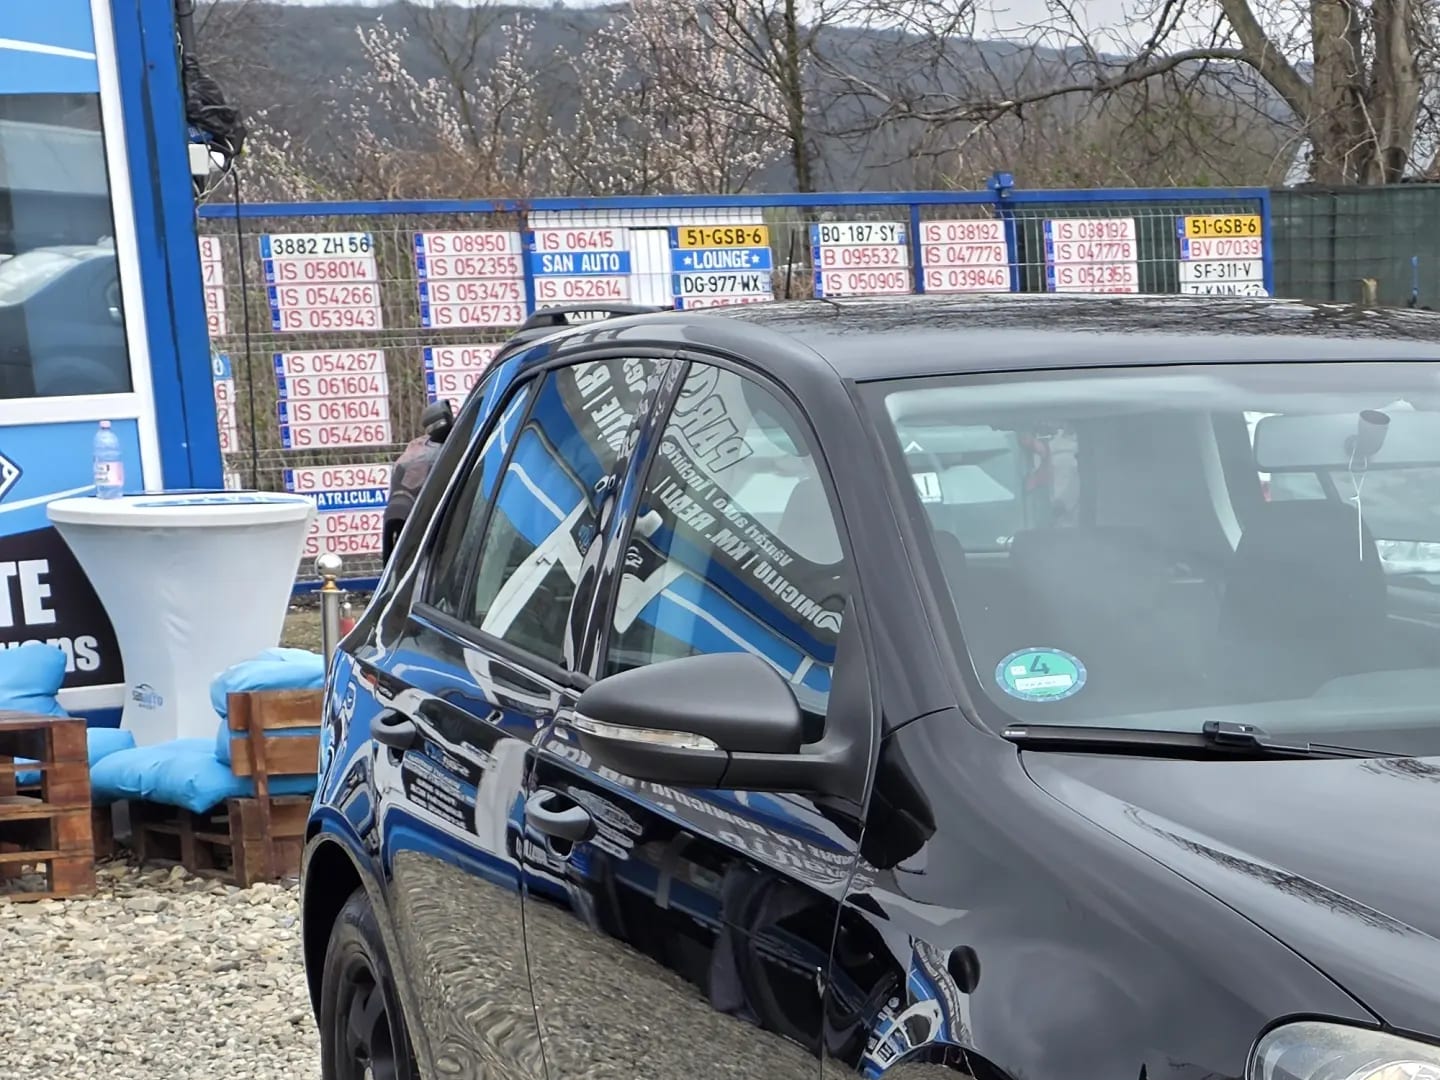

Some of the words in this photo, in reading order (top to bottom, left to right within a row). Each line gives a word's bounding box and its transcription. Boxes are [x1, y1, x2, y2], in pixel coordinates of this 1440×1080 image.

[925, 225, 941, 241] IS
[947, 223, 999, 241] 038192
[1058, 223, 1073, 239] IS
[1079, 222, 1128, 238] 038192
[1192, 219, 1256, 234] 51-GSB-6
[273, 238, 318, 255] 3882
[323, 237, 344, 253] ZH
[348, 236, 370, 253] 56
[428, 236, 446, 253] IS
[453, 234, 505, 252] 08950
[542, 233, 559, 250] IS
[566, 231, 614, 249] 06415
[687, 228, 762, 245] 51-GSB-6
[824, 249, 835, 265] B
[842, 248, 899, 265] 095532
[925, 247, 940, 263] IS
[947, 246, 1002, 262] 047778
[1057, 245, 1072, 260] IS
[1191, 240, 1212, 257] BV
[1216, 240, 1262, 256] 07039
[430, 259, 447, 276] IS
[455, 257, 518, 274] 052355
[542, 254, 574, 272] SAN
[581, 253, 620, 271] AUTO
[693, 250, 751, 269] LOUNGE
[279, 262, 298, 280] IS
[304, 261, 367, 279] 058014
[928, 271, 943, 287] IS
[949, 269, 1004, 286] 039846
[1058, 268, 1073, 284] IS
[1079, 267, 1132, 283] 052355
[1194, 262, 1251, 278] SF-311-V
[539, 280, 556, 297] IS
[564, 278, 621, 297] 052614
[684, 275, 760, 293] DG-977-WX
[826, 274, 842, 290] IS
[848, 272, 904, 289] 050905
[281, 288, 299, 306] IS
[306, 287, 373, 305] 054266
[432, 285, 450, 302] IS
[457, 283, 520, 300] 053475
[284, 311, 303, 328] IS
[309, 310, 376, 327] 053943
[435, 307, 452, 324] IS
[459, 305, 522, 323] 045733
[287, 356, 305, 373] IS
[312, 353, 377, 372] 054267
[437, 350, 454, 367] IS
[461, 349, 498, 366] 053
[292, 379, 311, 396] IS
[318, 376, 379, 394] 061604
[440, 374, 456, 392] IS
[293, 404, 312, 421] IS
[318, 401, 380, 419] 061604
[293, 428, 312, 446] IS
[318, 425, 385, 444] 054266
[297, 472, 315, 489] IS
[322, 468, 388, 487] 053942
[327, 514, 383, 533] 05482
[1030, 655, 1050, 674] 4
